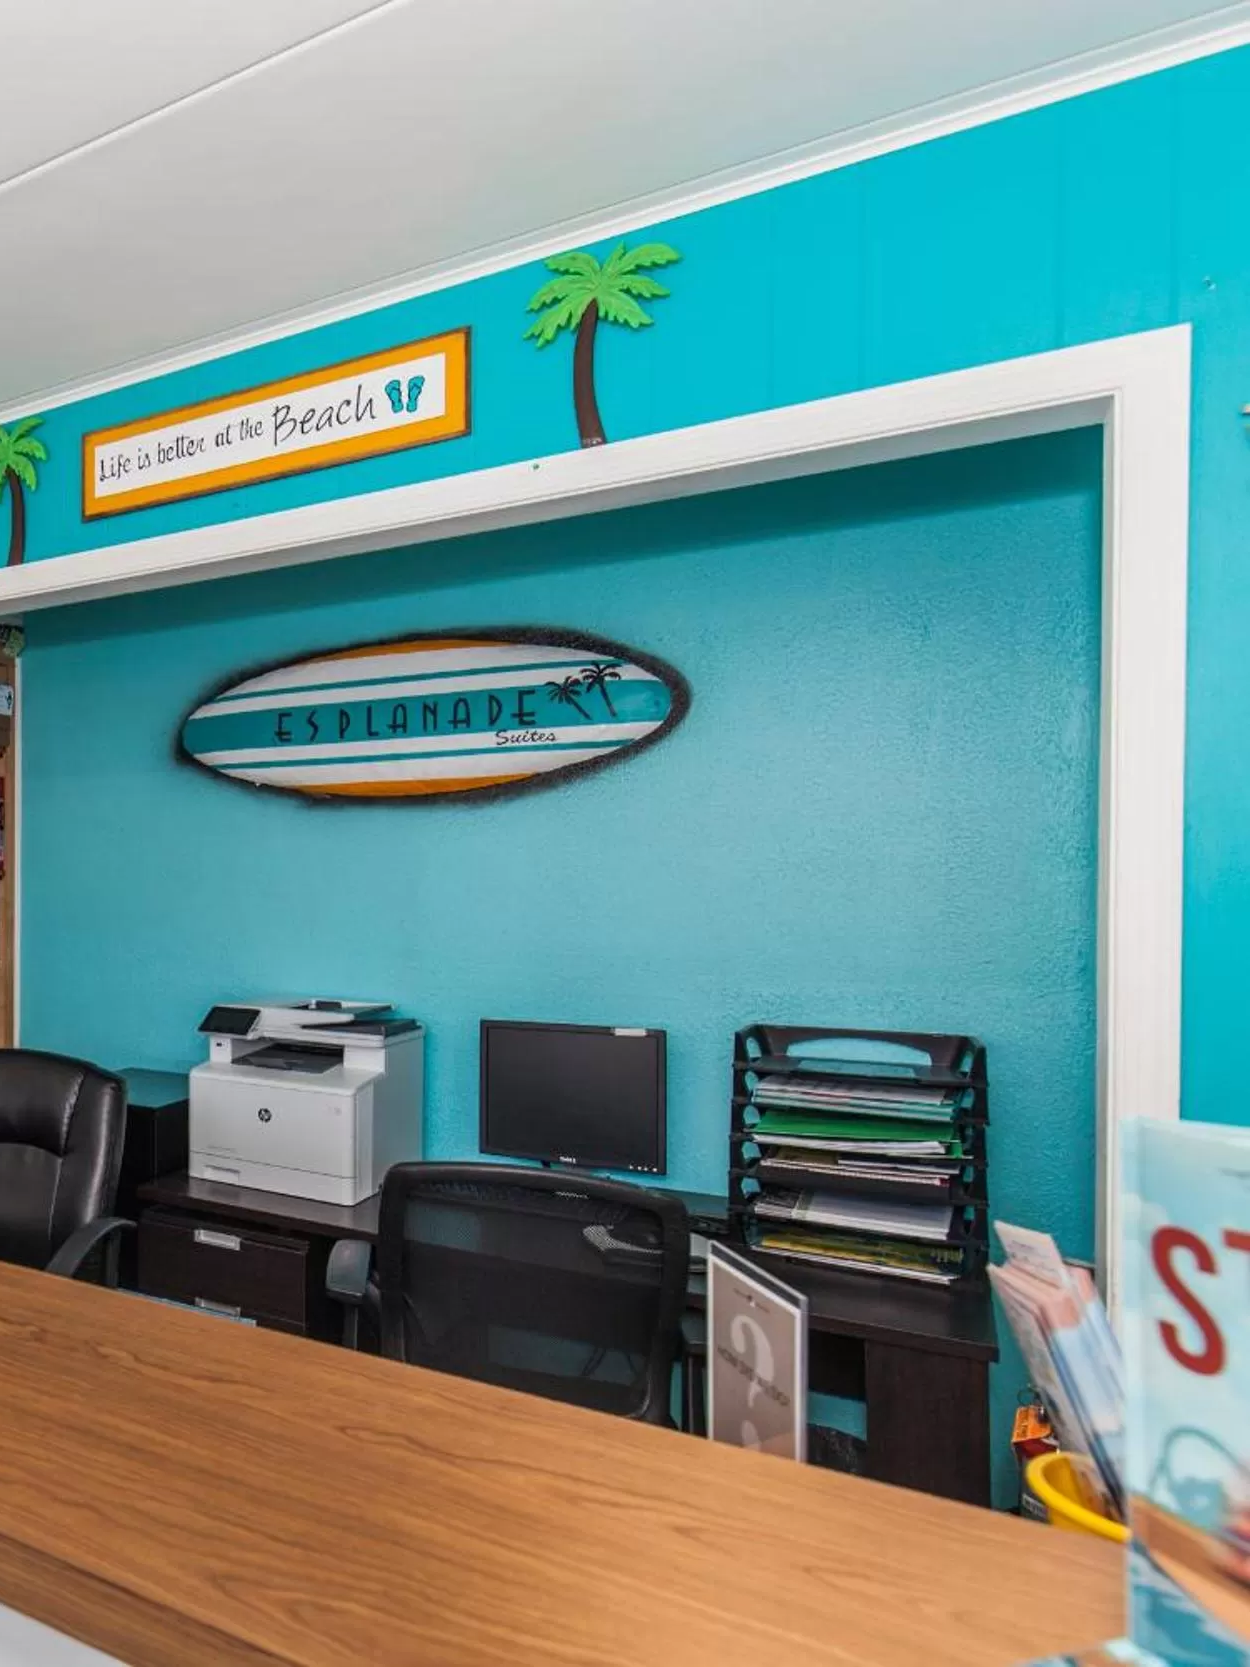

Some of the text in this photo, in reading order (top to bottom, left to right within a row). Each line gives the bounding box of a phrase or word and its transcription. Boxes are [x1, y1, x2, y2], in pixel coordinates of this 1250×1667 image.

[100, 385, 377, 482] Life is better at the Beach
[273, 689, 538, 744] ESPLANADE
[495, 729, 557, 746] Suites
